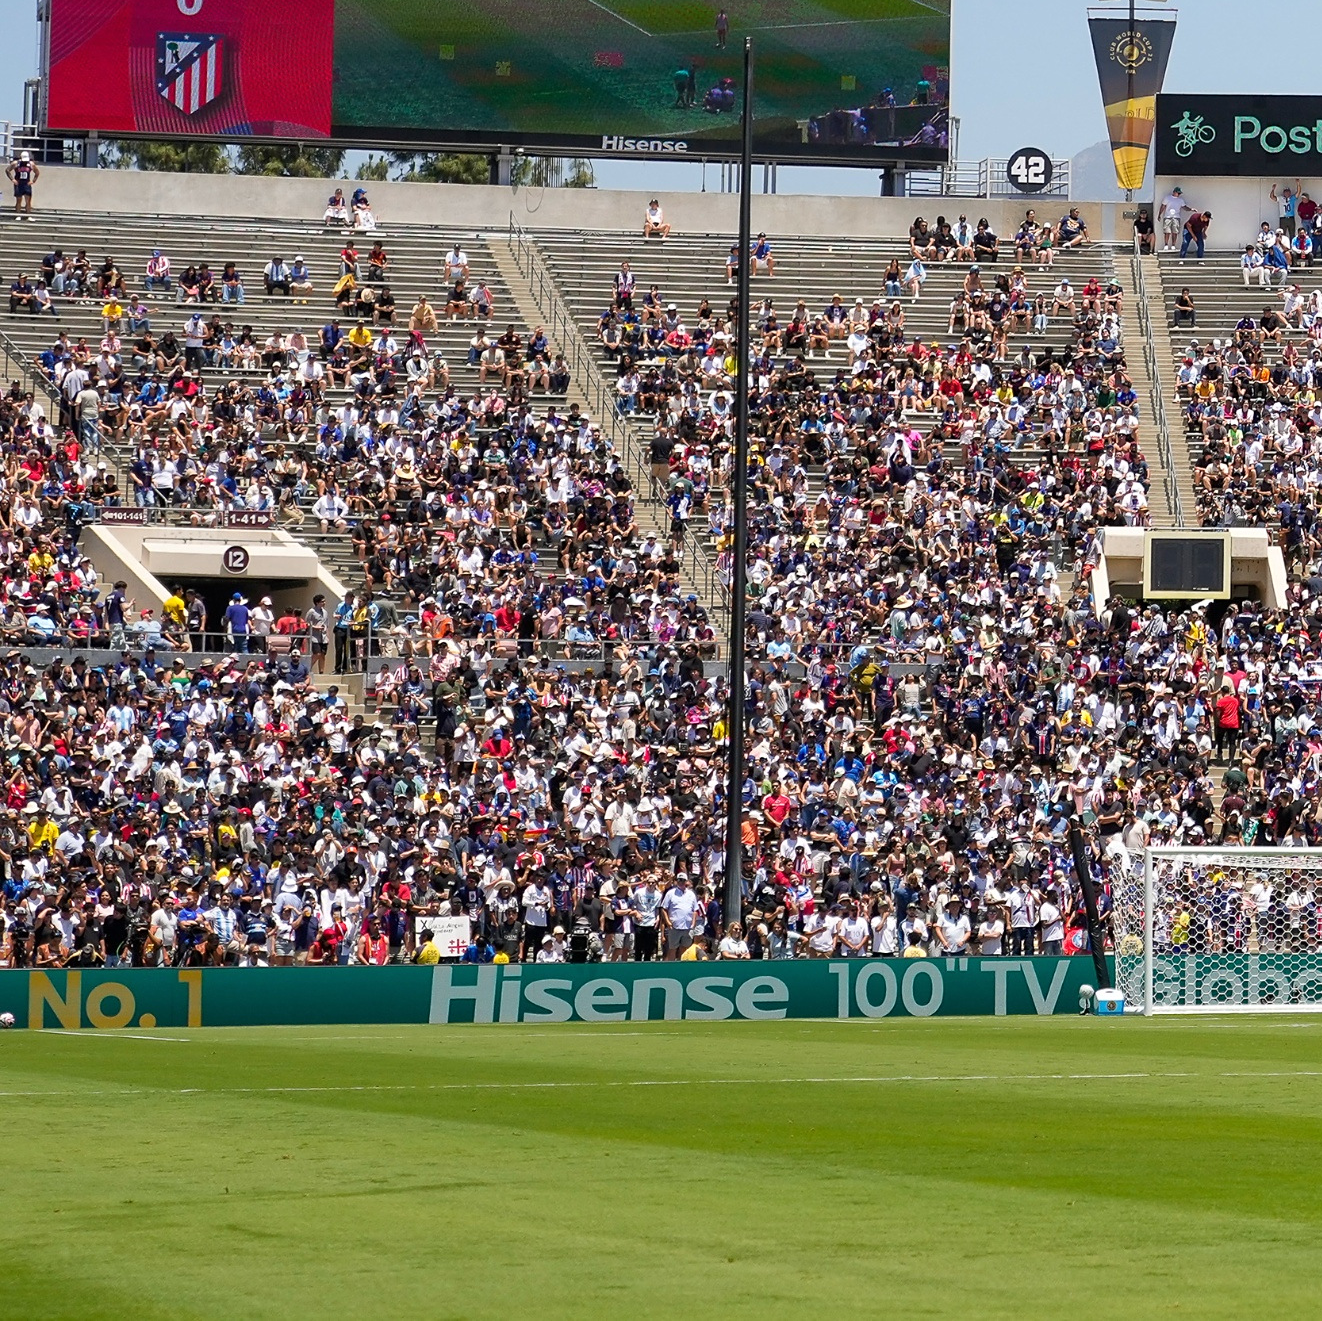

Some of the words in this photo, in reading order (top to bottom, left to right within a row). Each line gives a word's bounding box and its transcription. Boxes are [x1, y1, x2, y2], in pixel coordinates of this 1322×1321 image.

[1109, 41, 1117, 61] CLUB
[1115, 30, 1142, 42] WORLD
[1141, 35, 1153, 51] CUP
[601, 135, 688, 153] Hisense
[1010, 155, 1049, 185] 42
[113, 512, 143, 521] 101-141
[229, 514, 256, 525] 1-41
[228, 550, 244, 568] 12
[28, 970, 156, 1030] No.
[178, 970, 201, 1028] 1
[428, 965, 789, 1024] Hisense
[828, 960, 969, 1019] 100"
